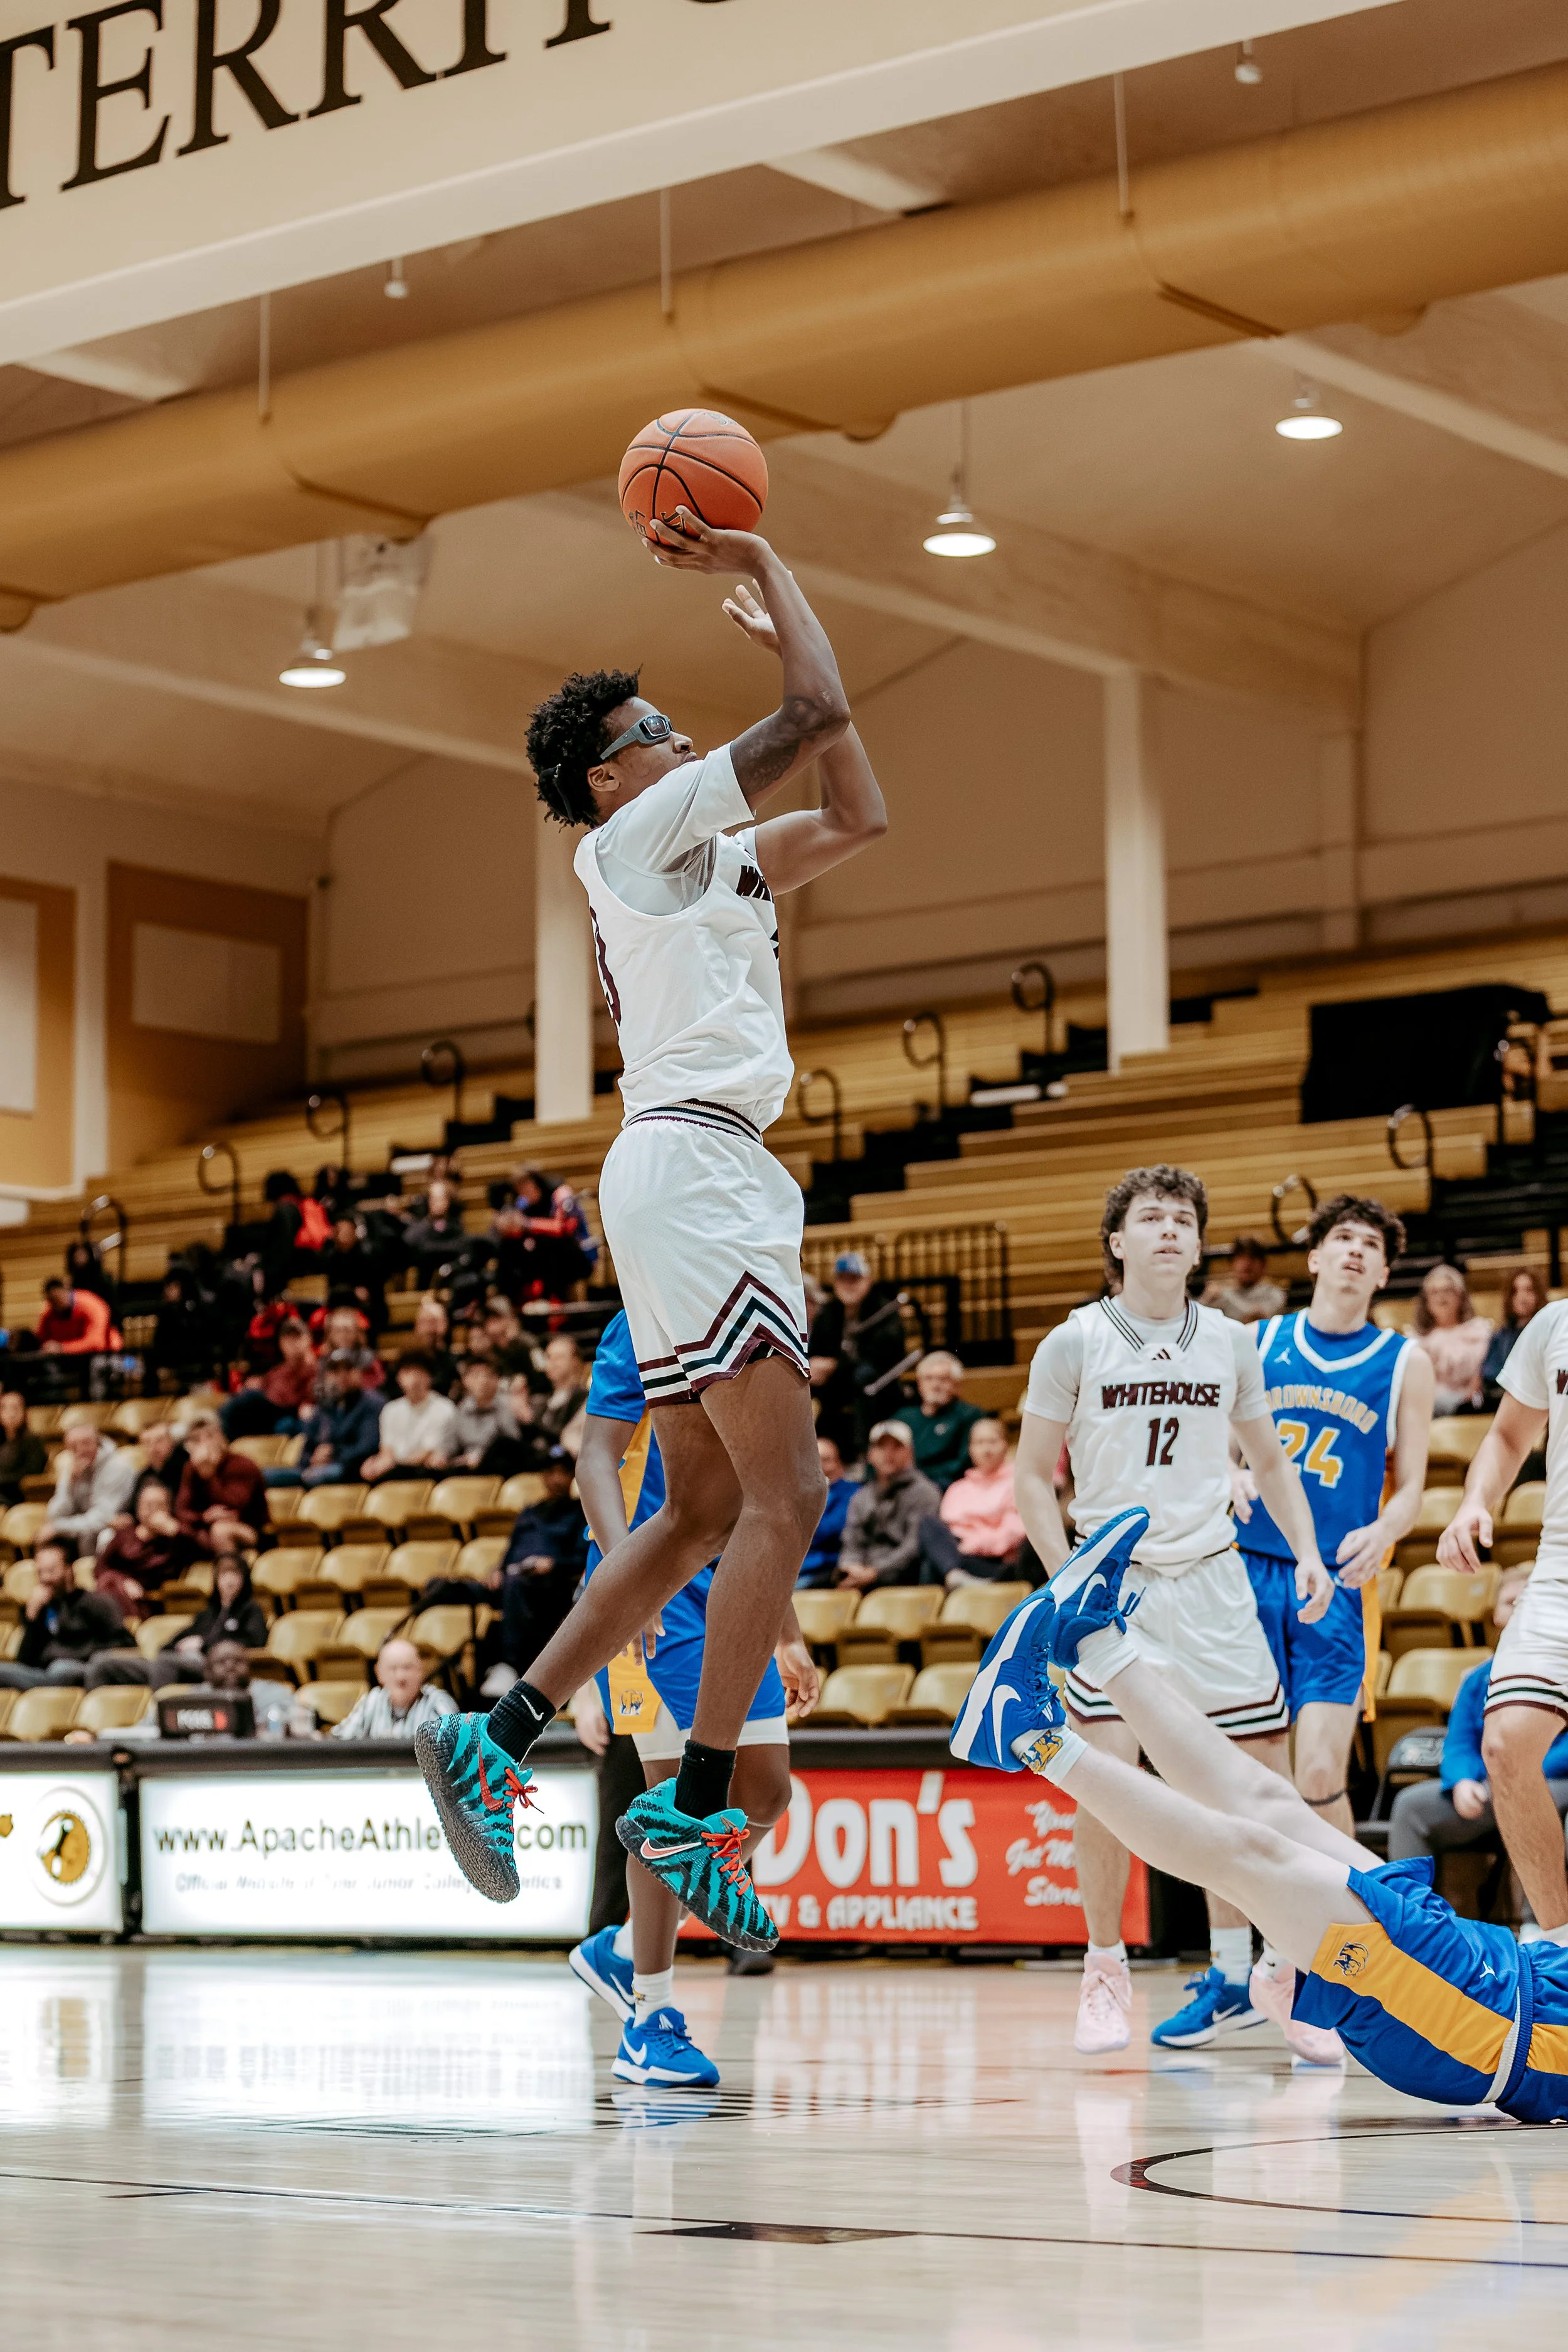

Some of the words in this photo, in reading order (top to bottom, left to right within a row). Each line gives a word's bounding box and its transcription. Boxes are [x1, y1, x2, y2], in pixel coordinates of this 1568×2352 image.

[1102, 1381, 1220, 1409] WHITEHOUSE
[1145, 1417, 1179, 1466] 12
[1276, 1418, 1344, 1489] 24
[755, 1771, 977, 1888] Don's
[797, 1894, 820, 1929] &
[826, 1895, 978, 1931] APPLIANCE
